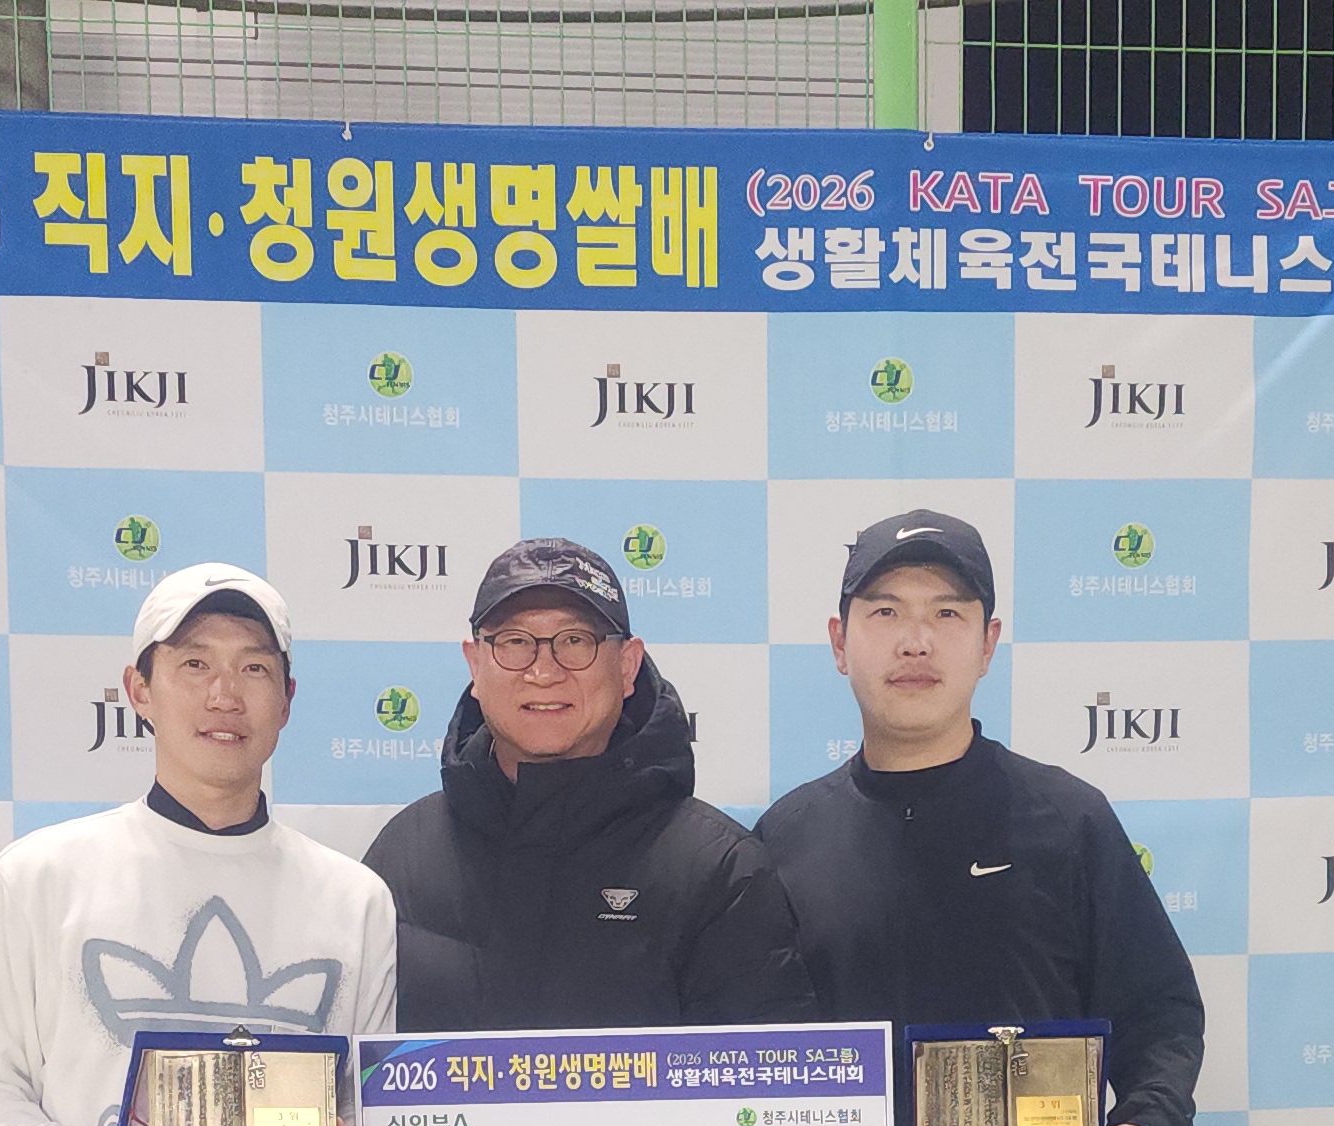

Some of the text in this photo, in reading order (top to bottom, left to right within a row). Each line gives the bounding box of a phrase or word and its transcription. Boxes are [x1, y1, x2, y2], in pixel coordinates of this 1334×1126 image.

[747, 168, 875, 216] (2026
[910, 171, 1049, 216] KATA
[1078, 173, 1226, 221] TOUR
[32, 151, 719, 290] 직지·청원생명쌀배
[78, 365, 188, 414] JIKJI
[590, 377, 695, 427] JIKJI
[1084, 378, 1184, 428] JIKJI
[323, 404, 460, 429] 청주시테니스협회
[826, 411, 958, 432] 청주시테니스협회
[68, 566, 166, 589] 청주시테니
[341, 539, 448, 589] JIKJI
[623, 576, 712, 598] 테니스협회
[1069, 575, 1197, 597] 청주시테니스협회
[87, 701, 156, 752] JIK
[1079, 705, 1180, 754] JIKJI
[331, 737, 441, 760] 청주시테니스
[382, 1051, 657, 1092] 2026 직지·청원생명쌀배
[667, 1047, 860, 1067] (2026 KATA TOUR SA그룹)
[666, 1064, 864, 1088] 생활체육전국테니스대회
[762, 1109, 862, 1126] 청주시테니스협회
